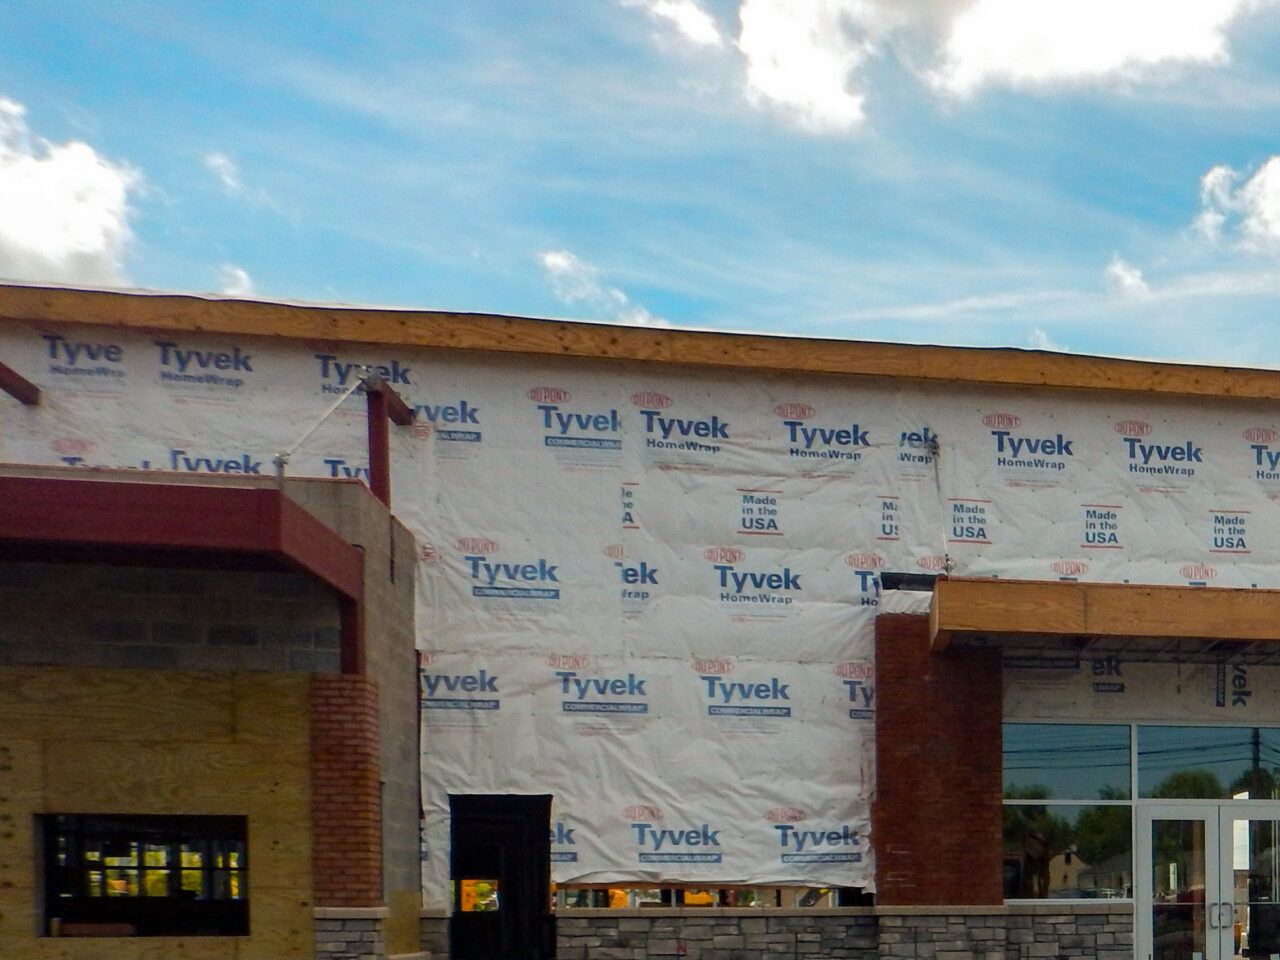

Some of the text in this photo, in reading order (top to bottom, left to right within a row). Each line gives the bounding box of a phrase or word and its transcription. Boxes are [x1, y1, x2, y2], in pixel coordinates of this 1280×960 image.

[42, 334, 124, 365] Tyve
[154, 340, 253, 372] Tyvek
[640, 411, 730, 440] Tyvek
[784, 421, 870, 449] Tyvek
[646, 438, 721, 454] HomeWrap
[991, 431, 1074, 458] Tyvek
[1123, 437, 1203, 464] Tyvek
[789, 448, 862, 461] HomeWrap
[997, 457, 1066, 470] HomeWrap
[1129, 463, 1195, 477] HomeWrap
[742, 494, 777, 506] Made
[742, 506, 778, 516] in the
[953, 504, 986, 514] Made
[1086, 510, 1117, 520] Made
[741, 518, 778, 531] USA
[953, 515, 986, 524] in the
[1086, 520, 1118, 530] in the
[1214, 515, 1245, 525] Made
[953, 527, 987, 539] USA
[1214, 525, 1246, 535] in the
[1085, 532, 1118, 544] USA
[1214, 537, 1246, 549] USA
[464, 555, 560, 585] Tyvek
[714, 565, 802, 593] Tyvek
[720, 592, 793, 605] HomeWrap
[555, 671, 647, 699] Tyvek
[700, 675, 790, 703] Tyvek
[631, 823, 720, 850] Tyvek
[774, 825, 861, 851] Tyvek
